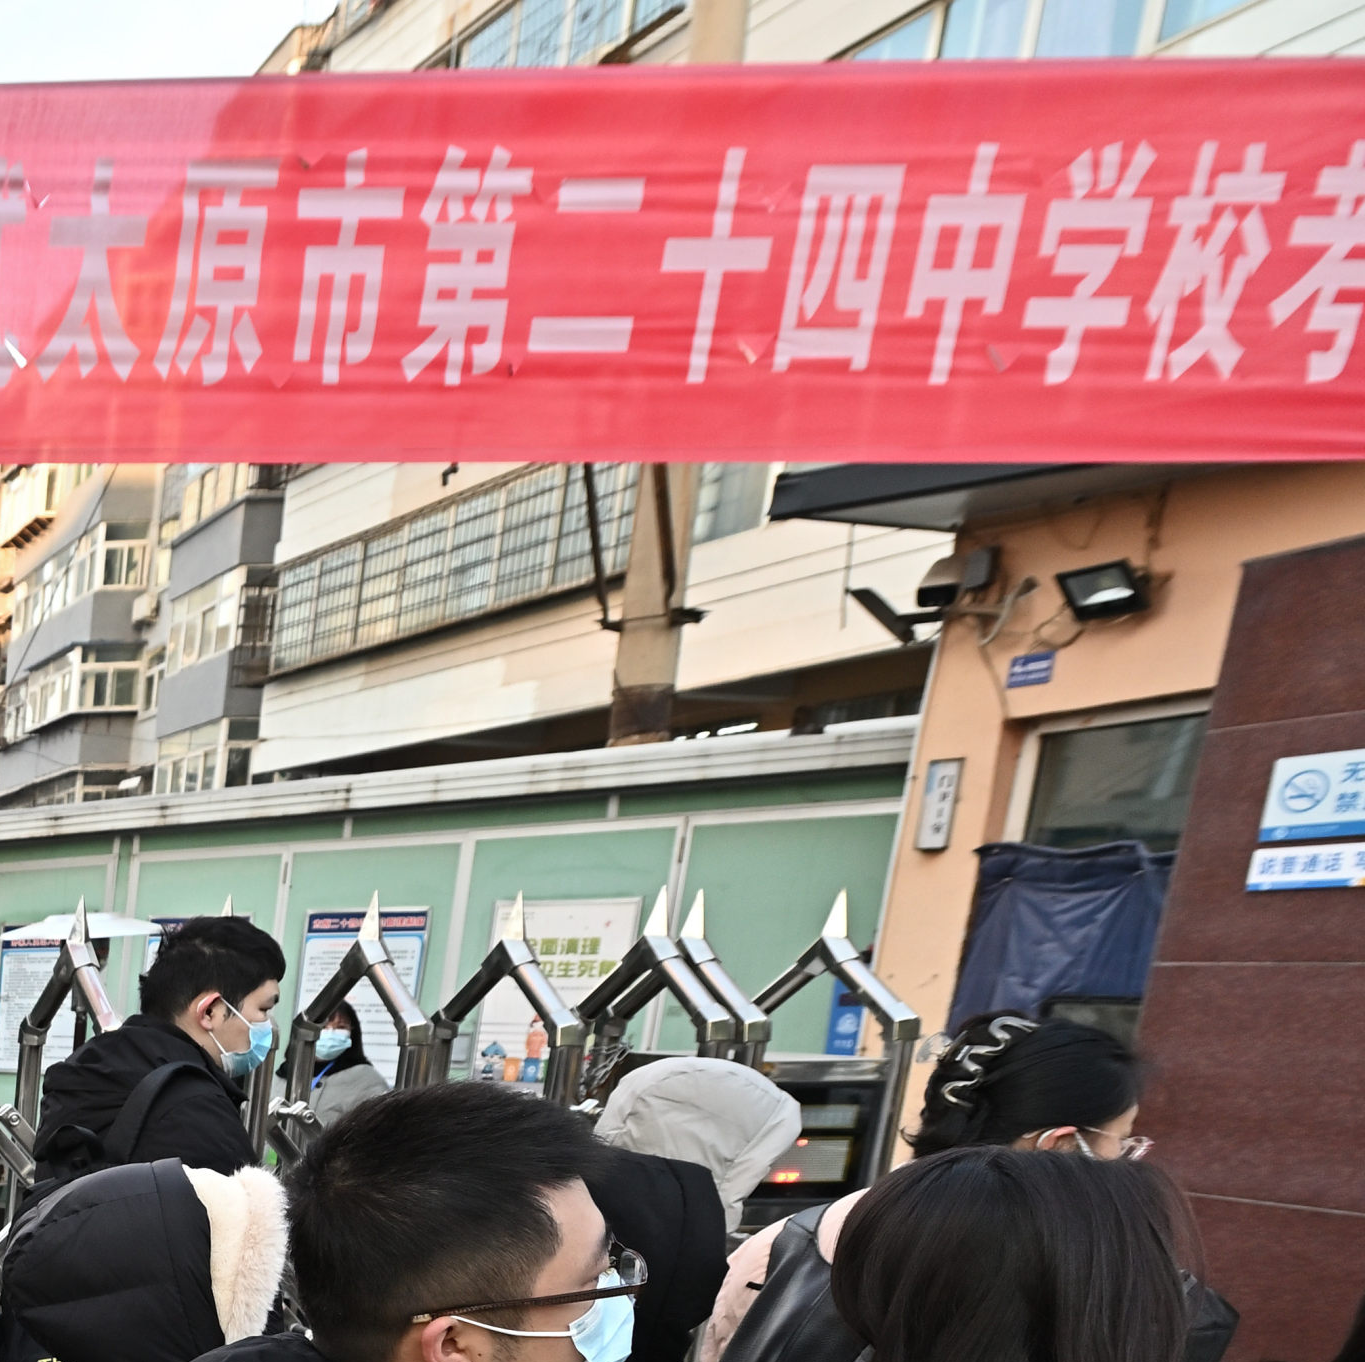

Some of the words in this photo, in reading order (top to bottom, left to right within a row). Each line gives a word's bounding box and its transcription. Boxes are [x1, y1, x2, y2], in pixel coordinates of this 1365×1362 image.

[1333, 791, 1365, 813] 禁
[1259, 851, 1344, 875] 说普通话
